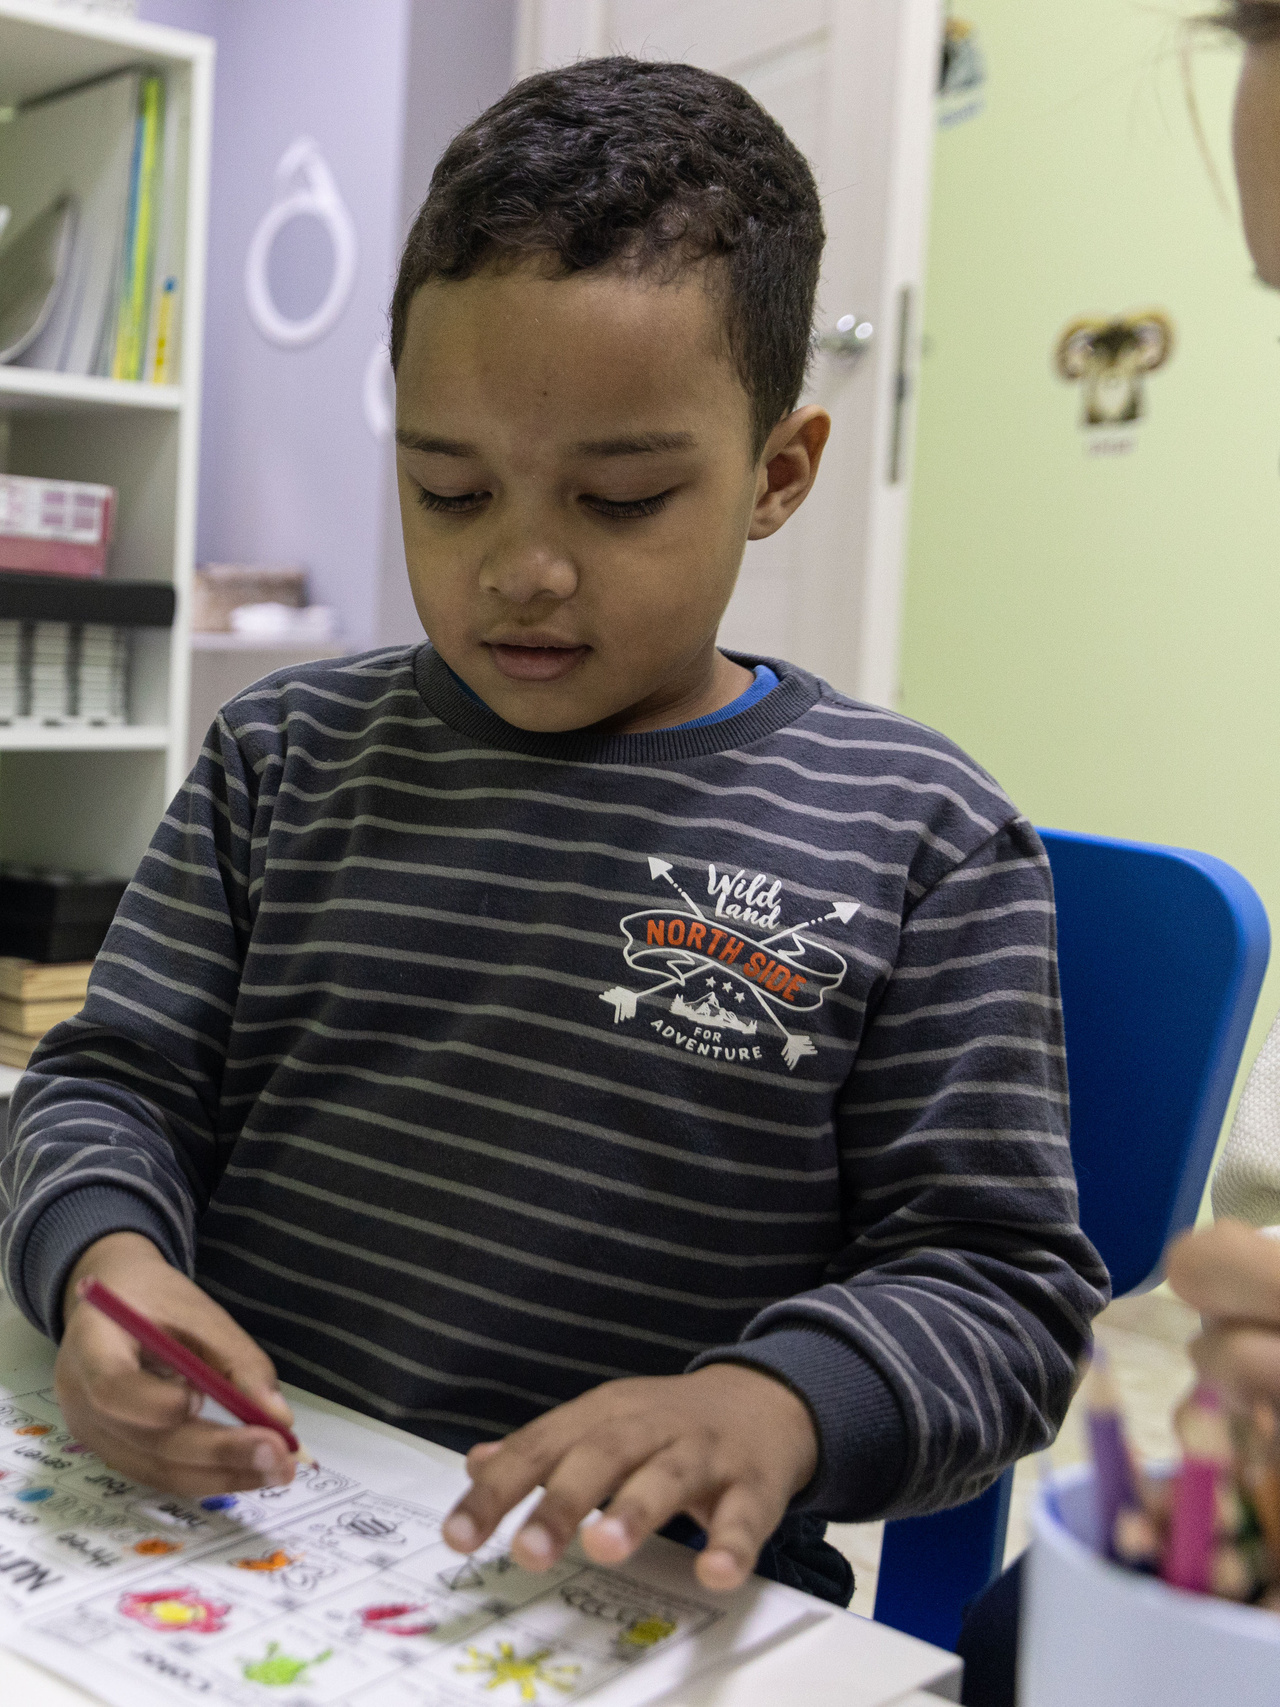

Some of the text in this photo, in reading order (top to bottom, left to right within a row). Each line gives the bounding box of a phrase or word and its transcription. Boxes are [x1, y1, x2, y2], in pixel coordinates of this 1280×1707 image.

[707, 863, 782, 910] Wild
[714, 894, 782, 930] Land
[646, 919, 807, 1001] NORTH SIDE
[650, 1018, 763, 1061] ADVENTURE
[693, 1026, 722, 1042] FOR
[13, 1445, 73, 1470] seven
[84, 1474, 136, 1498] four
[157, 1502, 209, 1527] nine
[55, 1531, 121, 1568] three
